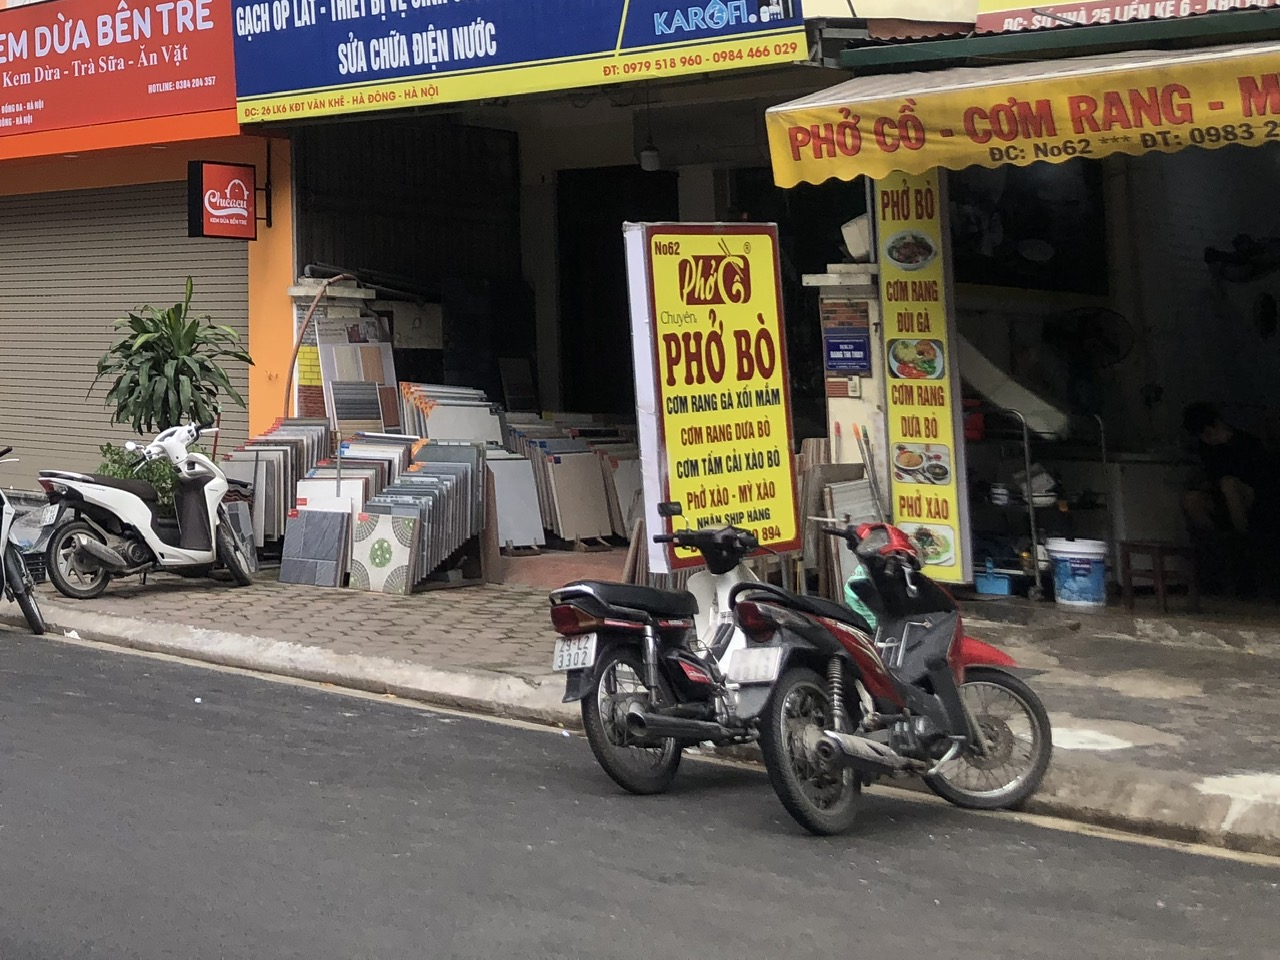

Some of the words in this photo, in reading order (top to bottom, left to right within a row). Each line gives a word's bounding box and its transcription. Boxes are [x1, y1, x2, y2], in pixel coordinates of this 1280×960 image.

[235, 2, 270, 42] GẠCH
[1091, 7, 1111, 24] 25
[34, 12, 91, 58] DỪA
[338, 31, 368, 75] SỬA
[370, 31, 411, 71] CHỮA
[412, 23, 450, 71] ĐIỆN
[453, 16, 497, 60] NƯỚC
[2, 71, 31, 88] Kem
[34, 64, 61, 83] Dừa
[71, 59, 96, 77] Trà
[98, 55, 125, 73] Sữa
[137, 44, 158, 68] Ăn
[161, 43, 188, 67] Vặt
[603, 65, 620, 77] ĐT:
[623, 61, 651, 75] 0979
[655, 57, 676, 71] 518
[680, 54, 702, 67] 960
[713, 49, 743, 64] 0984
[747, 45, 771, 60] 466
[773, 42, 798, 56] 029
[147, 82, 176, 94] HOTLINE:
[204, 75, 216, 87] 357
[244, 107, 260, 117] ĐC:
[261, 105, 272, 116] 26
[272, 104, 287, 115] LK6
[289, 101, 305, 112] KĐT
[306, 97, 326, 110] VĂN
[352, 92, 365, 106] HÀ
[367, 90, 396, 103] ĐÔNG
[404, 86, 418, 100] HÀ
[420, 85, 439, 101] NỘI
[787, 106, 862, 162] PHỞ
[873, 98, 925, 153] CỒ
[963, 97, 1057, 144] CƠM
[1067, 83, 1195, 135] RANG
[1033, 139, 1093, 158] No62
[1140, 130, 1183, 149] ĐT:
[1189, 122, 1255, 144] 0983
[880, 178, 911, 221] PHỞ
[914, 182, 935, 221] BÒ
[654, 241, 680, 256] No62
[886, 278, 910, 302] CƠM
[911, 280, 939, 302] RANG
[897, 307, 915, 333] ĐÙI
[916, 307, 932, 334] GÀ
[662, 308, 726, 387] PHỞ
[733, 312, 776, 381] BÒ
[666, 394, 689, 415] CƠM
[691, 393, 718, 413] RANG
[720, 388, 734, 411] GÀ
[736, 384, 753, 409] XỐI
[891, 382, 915, 406] CƠM
[917, 384, 945, 407] RANG
[680, 424, 704, 446] CƠM
[706, 423, 733, 443] RANG
[735, 419, 756, 440] DƯA
[757, 414, 771, 438] BÒ
[924, 412, 938, 439] BÒ
[676, 457, 700, 479] CƠM
[701, 450, 724, 476] TẤM
[726, 447, 742, 473] CẢI
[744, 448, 765, 471] XÀO
[767, 445, 781, 468] BÒ
[709, 484, 729, 508] XÀO
[738, 480, 753, 504] MỲ
[755, 478, 776, 501] XÀO
[898, 489, 922, 518] PHỞ
[925, 492, 949, 520] XÀO
[747, 507, 771, 523] HÀNG
[762, 526, 782, 542] 894
[558, 650, 588, 667] 3302
